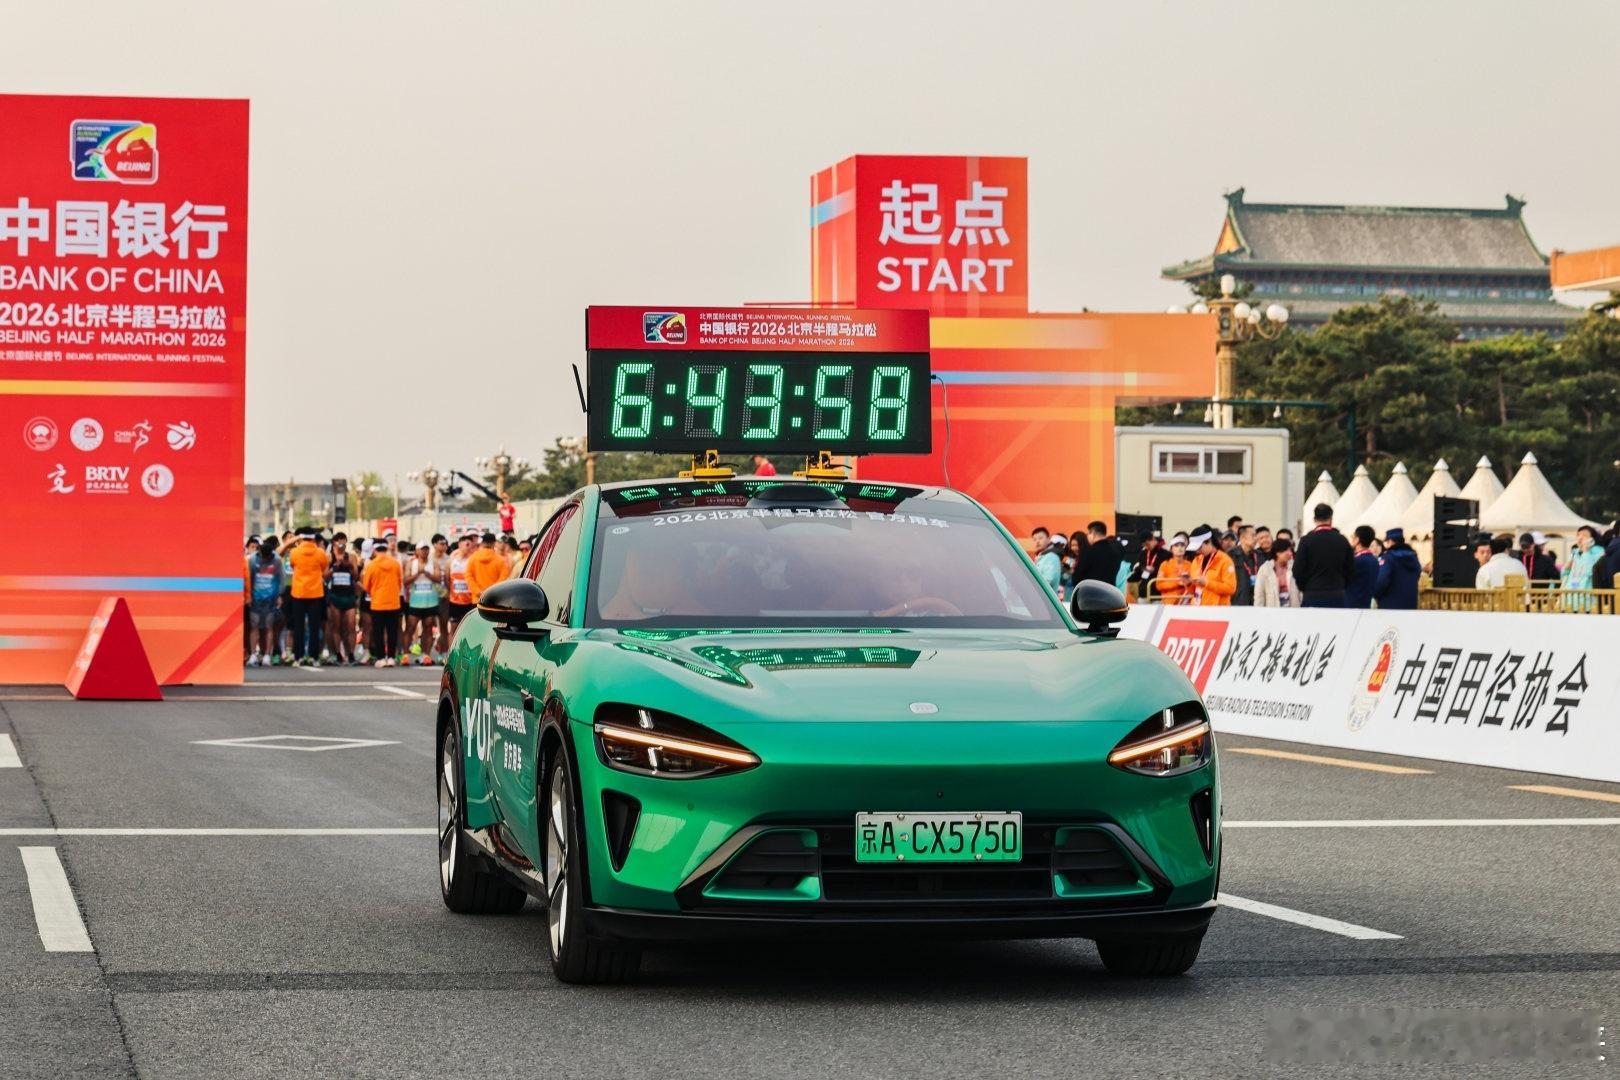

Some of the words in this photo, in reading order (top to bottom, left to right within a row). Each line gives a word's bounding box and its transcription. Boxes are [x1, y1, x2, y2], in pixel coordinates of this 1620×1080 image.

[116, 162, 151, 171] BEIJING
[878, 179, 1010, 246] 起点
[0, 197, 228, 259] 中国银行
[0, 265, 79, 291] BANK
[85, 266, 127, 292] OF
[133, 267, 225, 294] CHINA
[876, 256, 1014, 293] START
[0, 329, 51, 344] BEIJING
[56, 331, 95, 344] HALF
[100, 331, 186, 346] MARATHON
[191, 333, 227, 347] 2026
[611, 362, 911, 440] 6:43:58
[86, 466, 130, 481] BRTV
[865, 511, 950, 528] 官方用车
[1393, 643, 1588, 737] 中国田径协会
[1283, 703, 1314, 721] STATION
